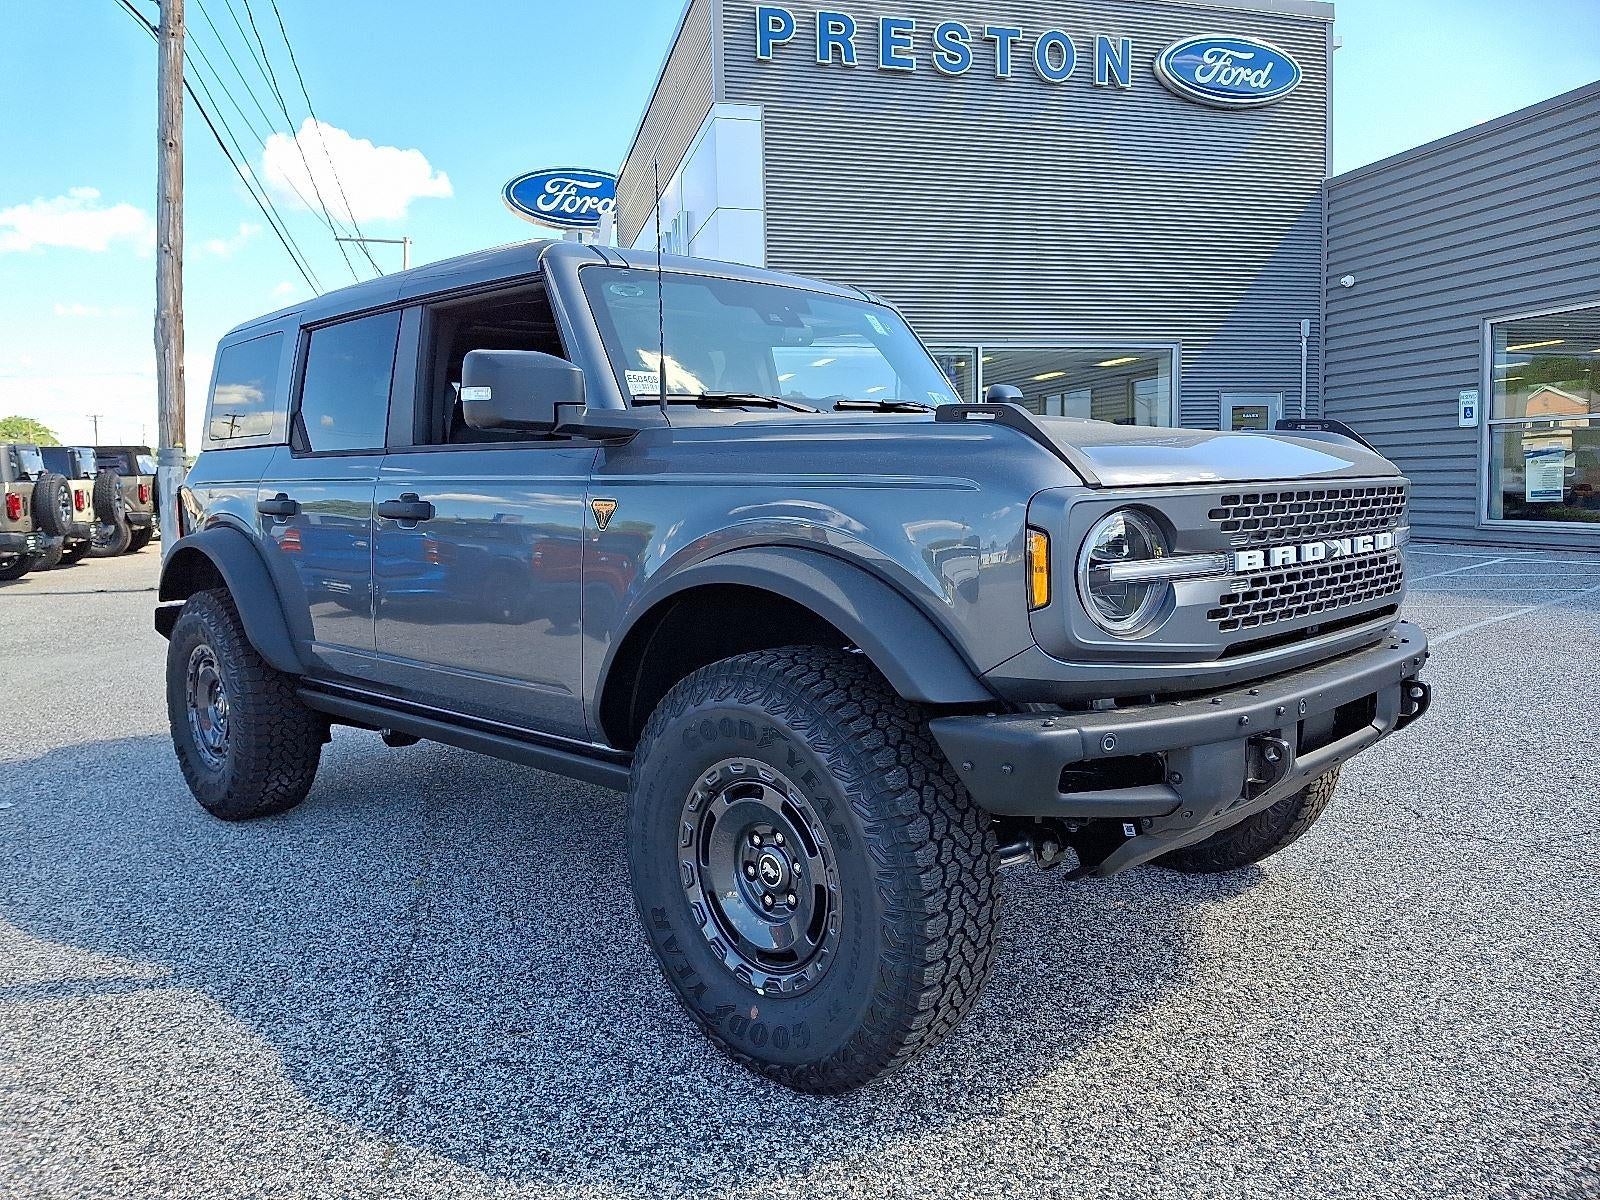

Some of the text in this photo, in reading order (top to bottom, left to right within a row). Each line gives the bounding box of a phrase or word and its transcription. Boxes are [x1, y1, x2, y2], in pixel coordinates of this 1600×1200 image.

[756, 5, 1132, 89] PRESTON
[1194, 47, 1274, 89] Ford
[1234, 532, 1393, 572] BRONCO
